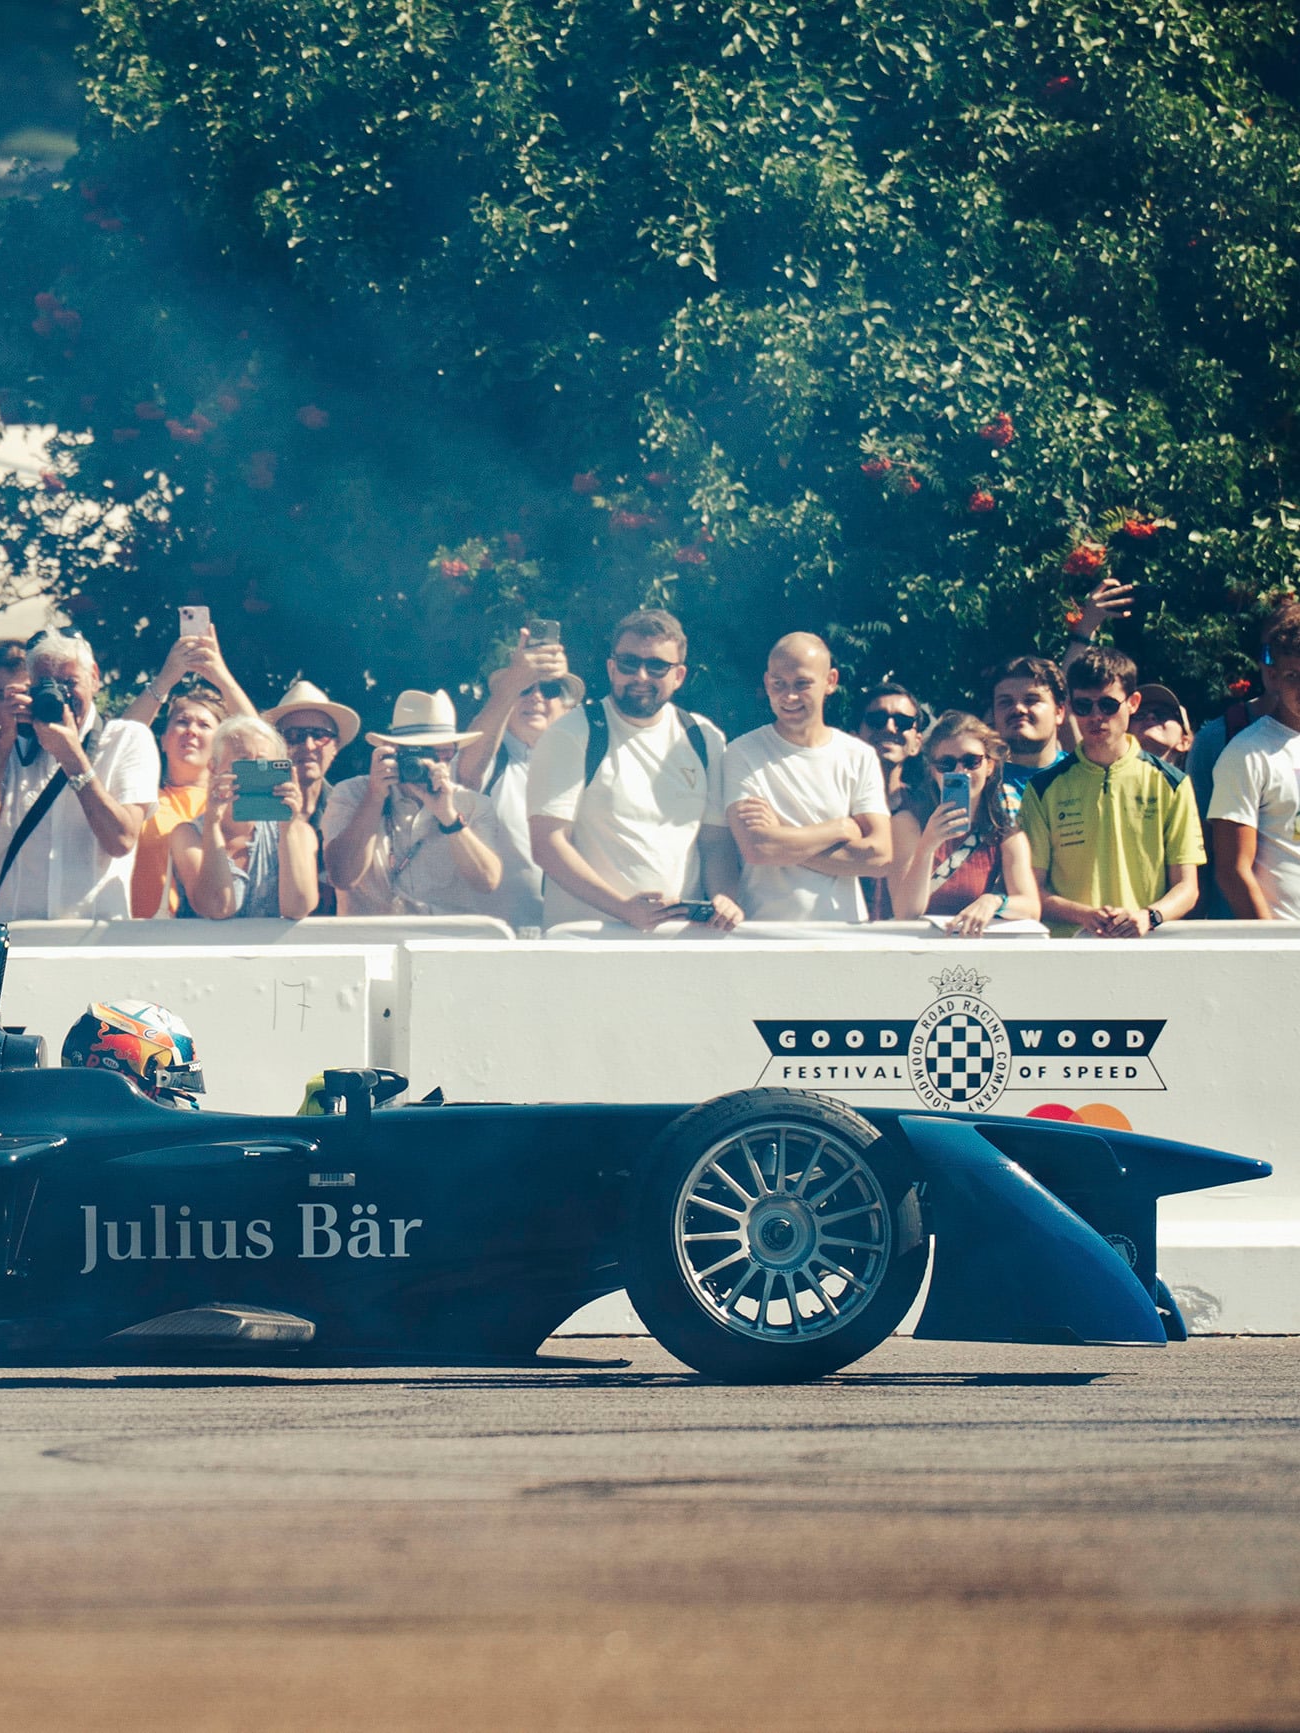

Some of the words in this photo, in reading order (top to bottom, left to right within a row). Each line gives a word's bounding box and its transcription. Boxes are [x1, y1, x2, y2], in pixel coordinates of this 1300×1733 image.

[921, 1000, 955, 1030] ROAD
[962, 1000, 1005, 1044] RACING
[778, 1029, 899, 1049] GOOD
[1019, 1029, 1145, 1049] WOOD
[783, 1066, 902, 1079] FESTIVAL
[1019, 1066, 1047, 1079] OF
[1062, 1066, 1138, 1079] SPEED
[911, 1035, 951, 1112] GOODWOOD
[80, 1204, 275, 1274] Julius
[297, 1202, 423, 1259] Bär
